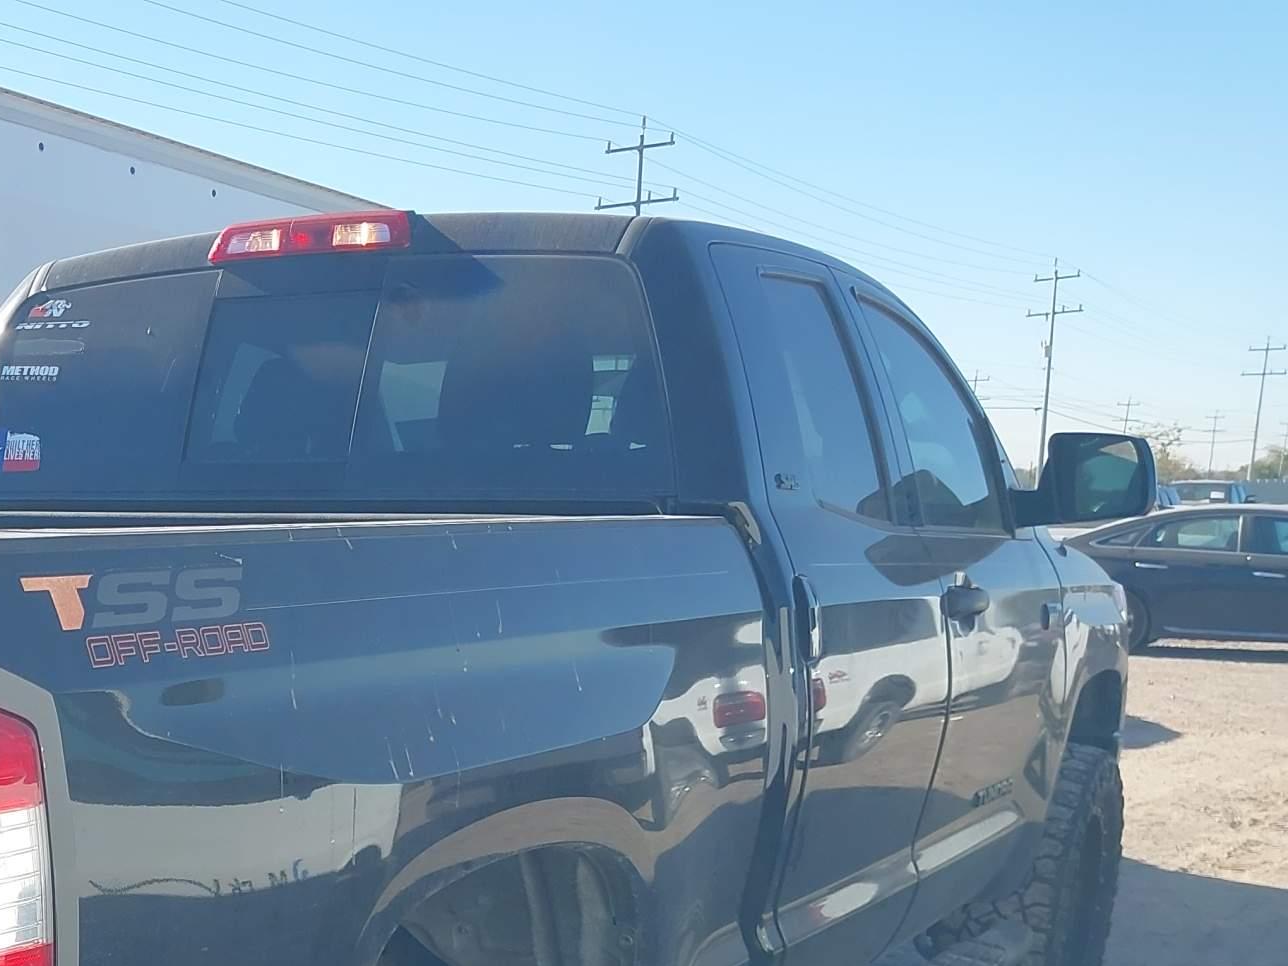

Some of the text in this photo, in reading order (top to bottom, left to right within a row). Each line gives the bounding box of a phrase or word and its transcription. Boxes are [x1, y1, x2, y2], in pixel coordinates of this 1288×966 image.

[15, 320, 90, 330] NITTO
[1, 365, 59, 376] METHOD
[85, 621, 270, 668] OFF-ROAD
